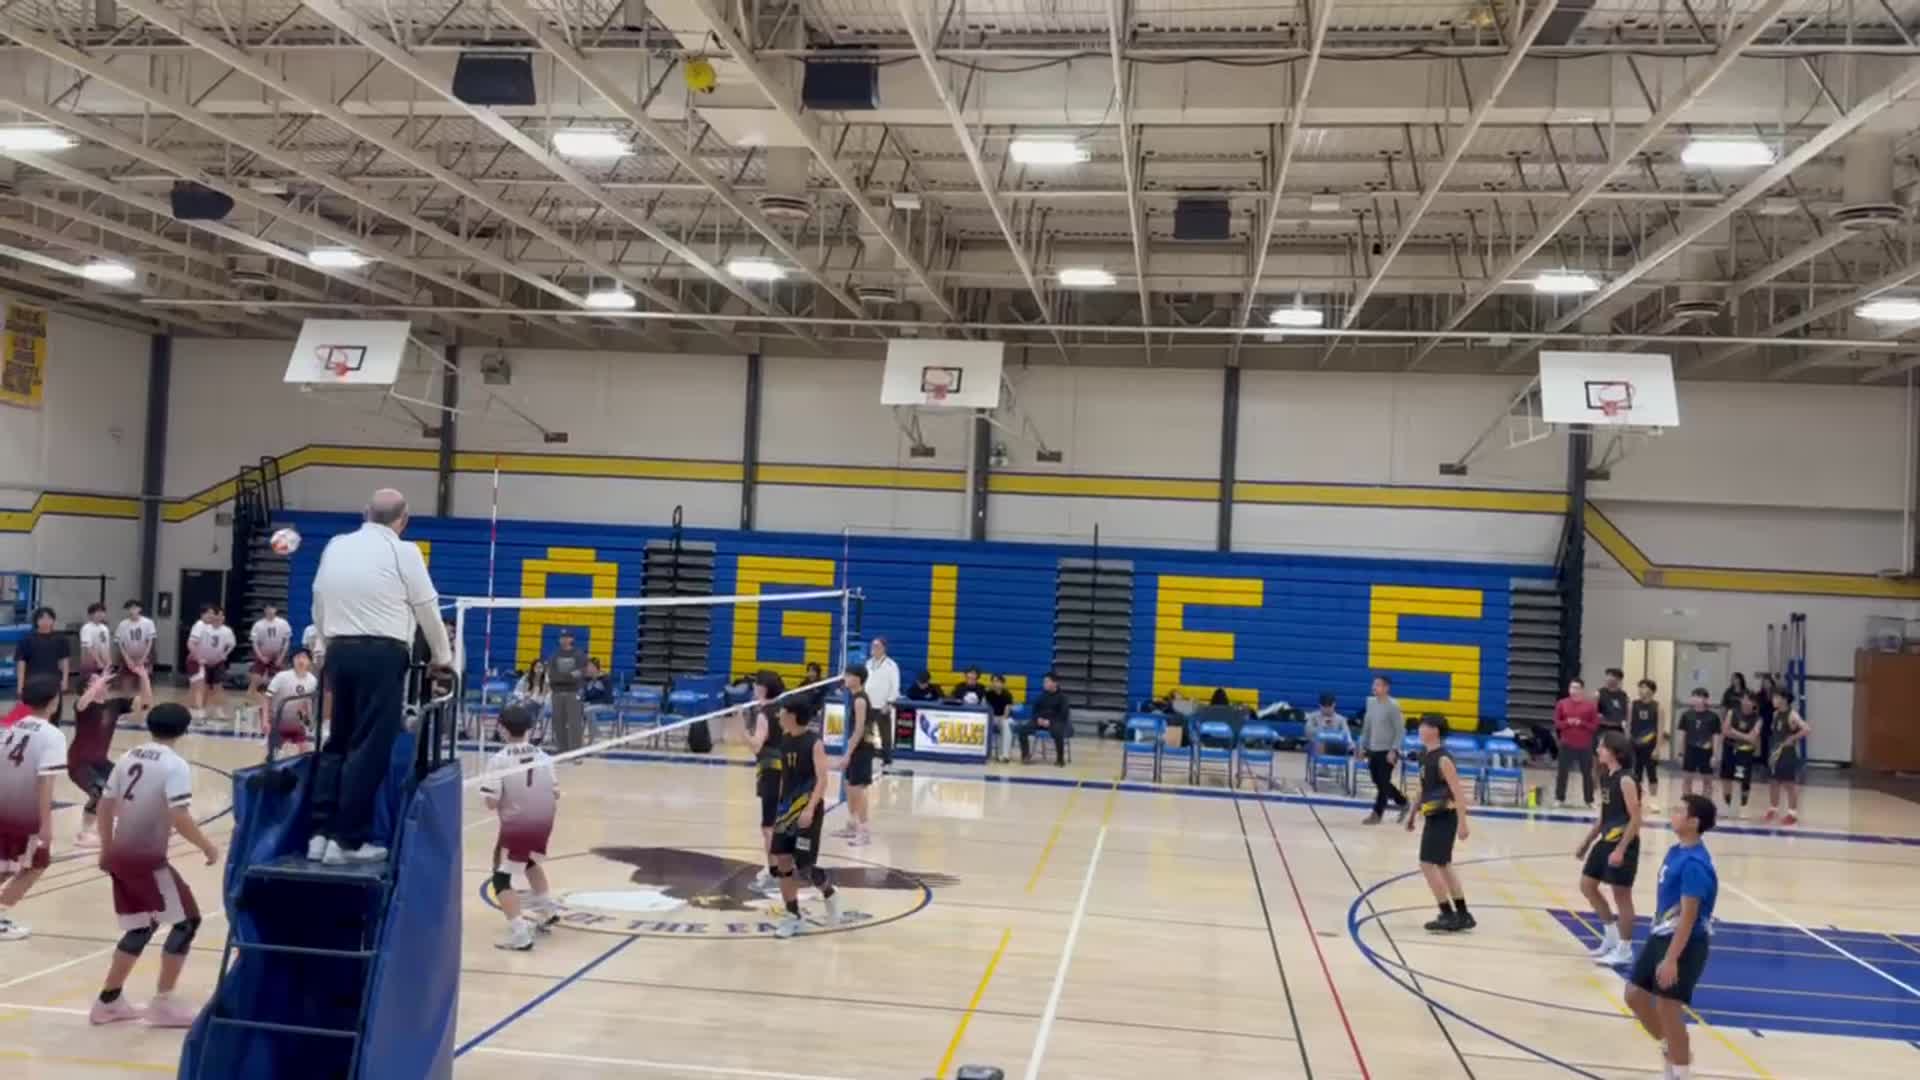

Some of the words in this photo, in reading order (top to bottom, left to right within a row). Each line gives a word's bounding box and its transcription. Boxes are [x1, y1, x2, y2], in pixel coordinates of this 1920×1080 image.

[413, 541, 1483, 732] AGLES
[123, 763, 143, 801] 2
[627, 918, 709, 934] THE
